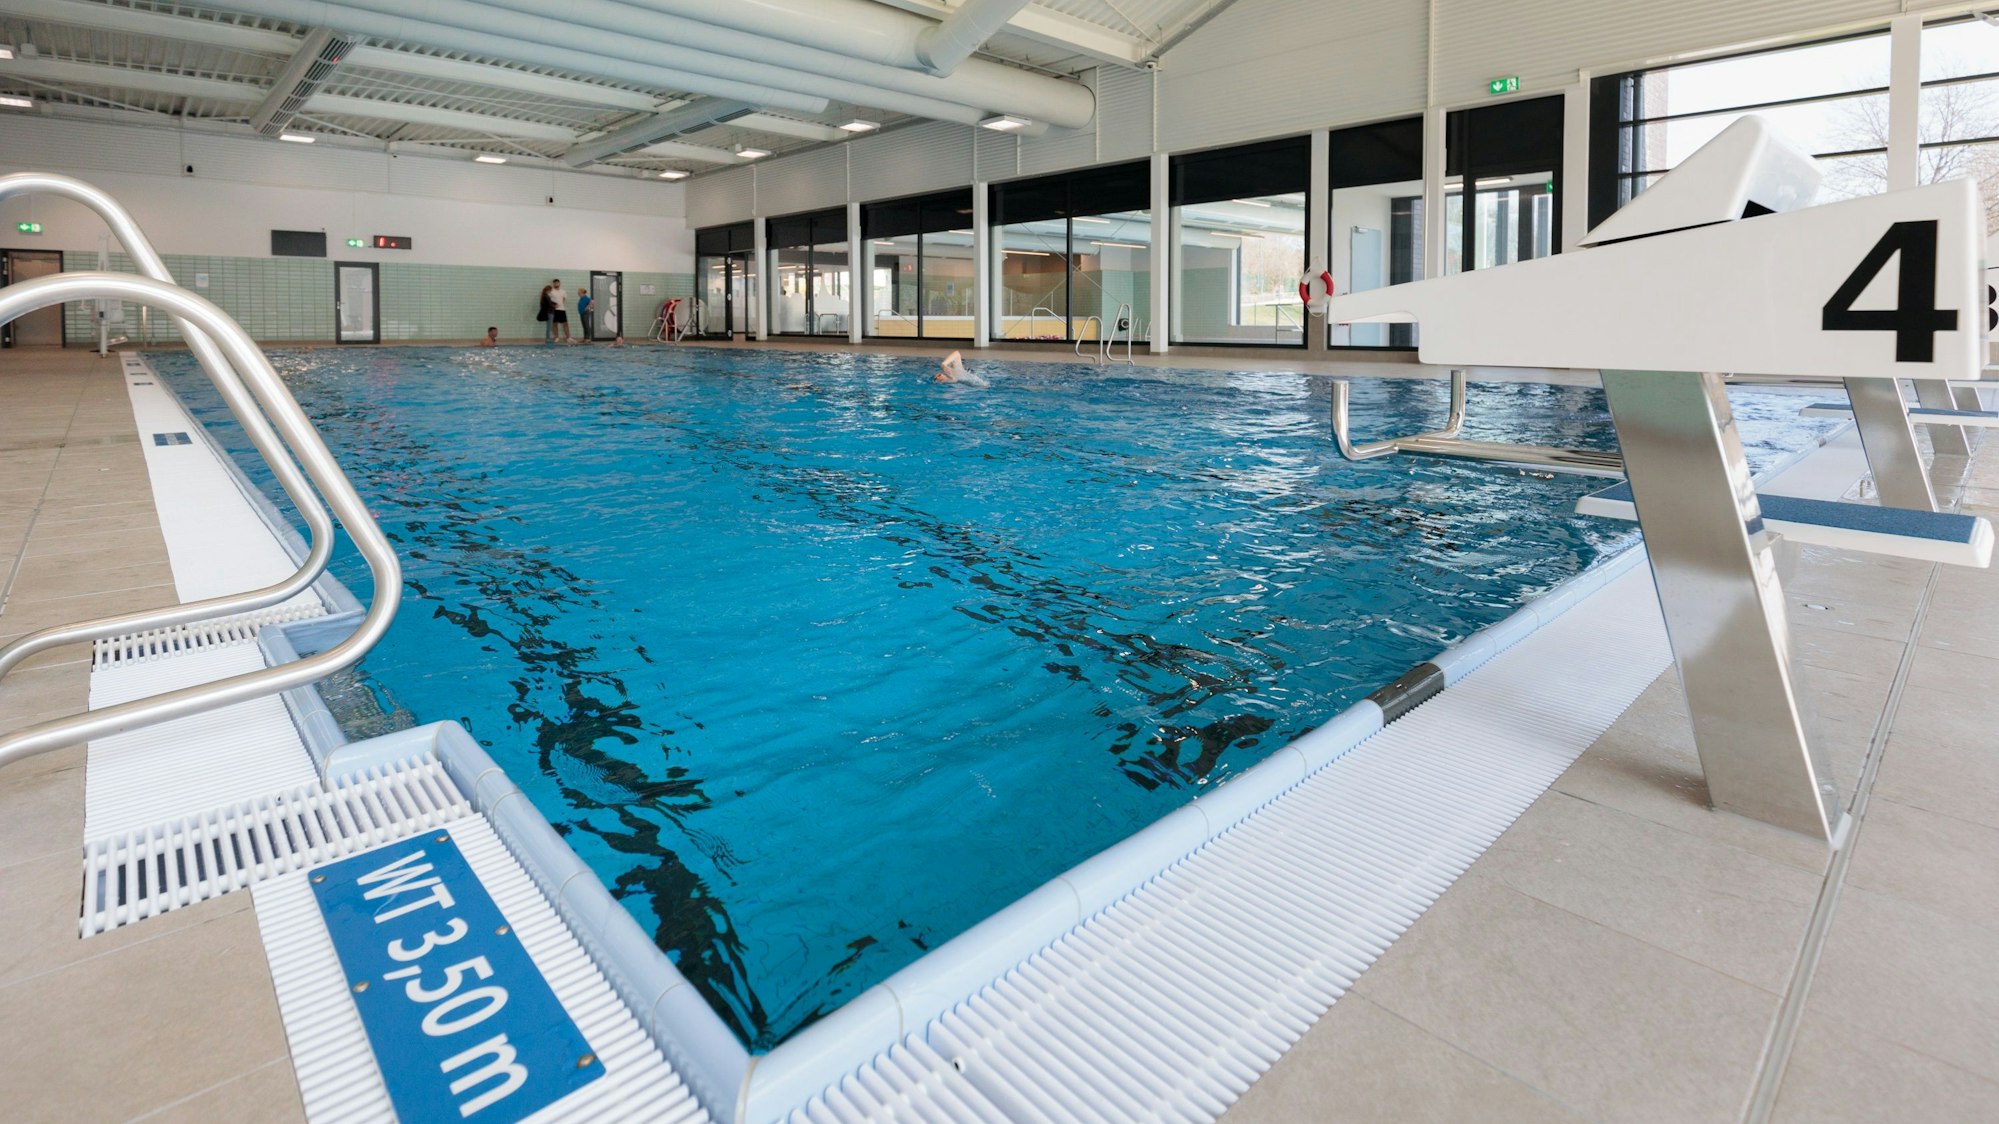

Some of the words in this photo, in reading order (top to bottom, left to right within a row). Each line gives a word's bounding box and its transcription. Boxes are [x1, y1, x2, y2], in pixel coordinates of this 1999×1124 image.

[1822, 219, 1958, 363] 4
[356, 849, 456, 924] WT
[383, 917, 509, 1037] 3,50
[440, 1032, 529, 1118] m
